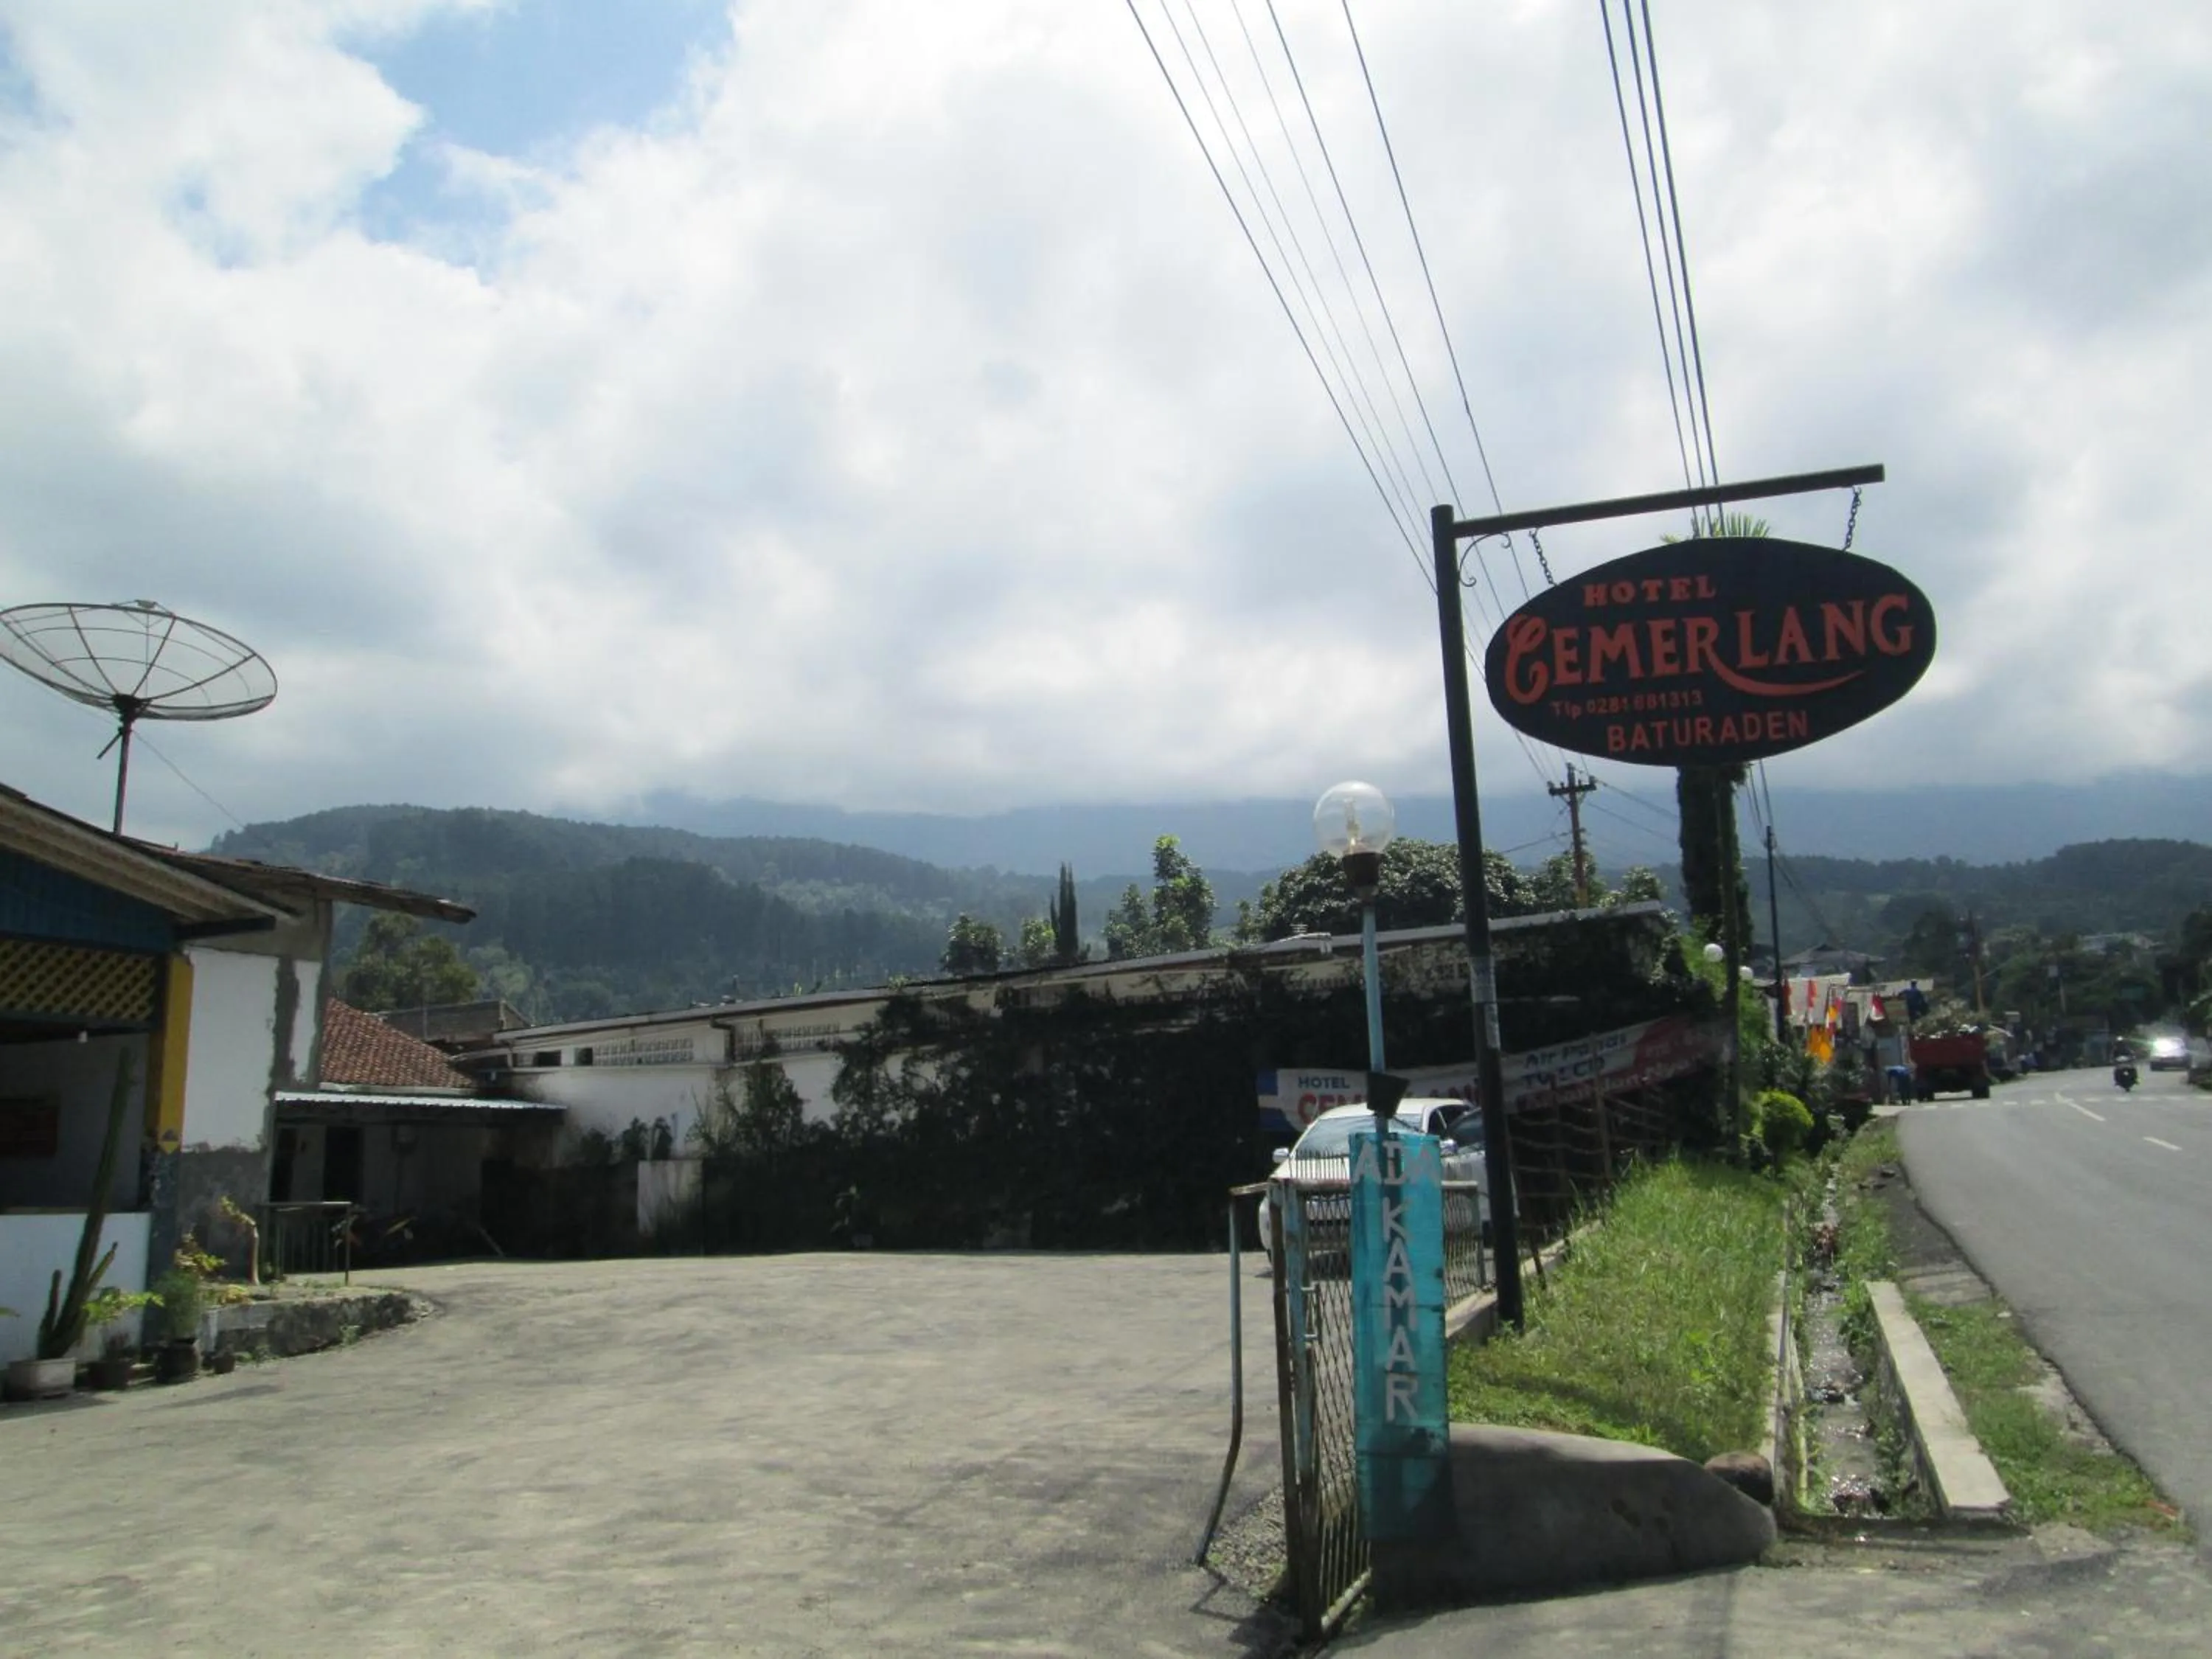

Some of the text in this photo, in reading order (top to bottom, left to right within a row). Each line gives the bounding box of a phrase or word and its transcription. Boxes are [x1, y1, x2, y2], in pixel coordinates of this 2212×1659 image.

[1582, 574, 1717, 608] HOTEL
[1504, 593, 1914, 706] CEMERLANG
[1606, 710, 1809, 754] BATURADEN
[1298, 1076, 1351, 1090] HOTEL
[1382, 1196, 1420, 1423] KAMAR
